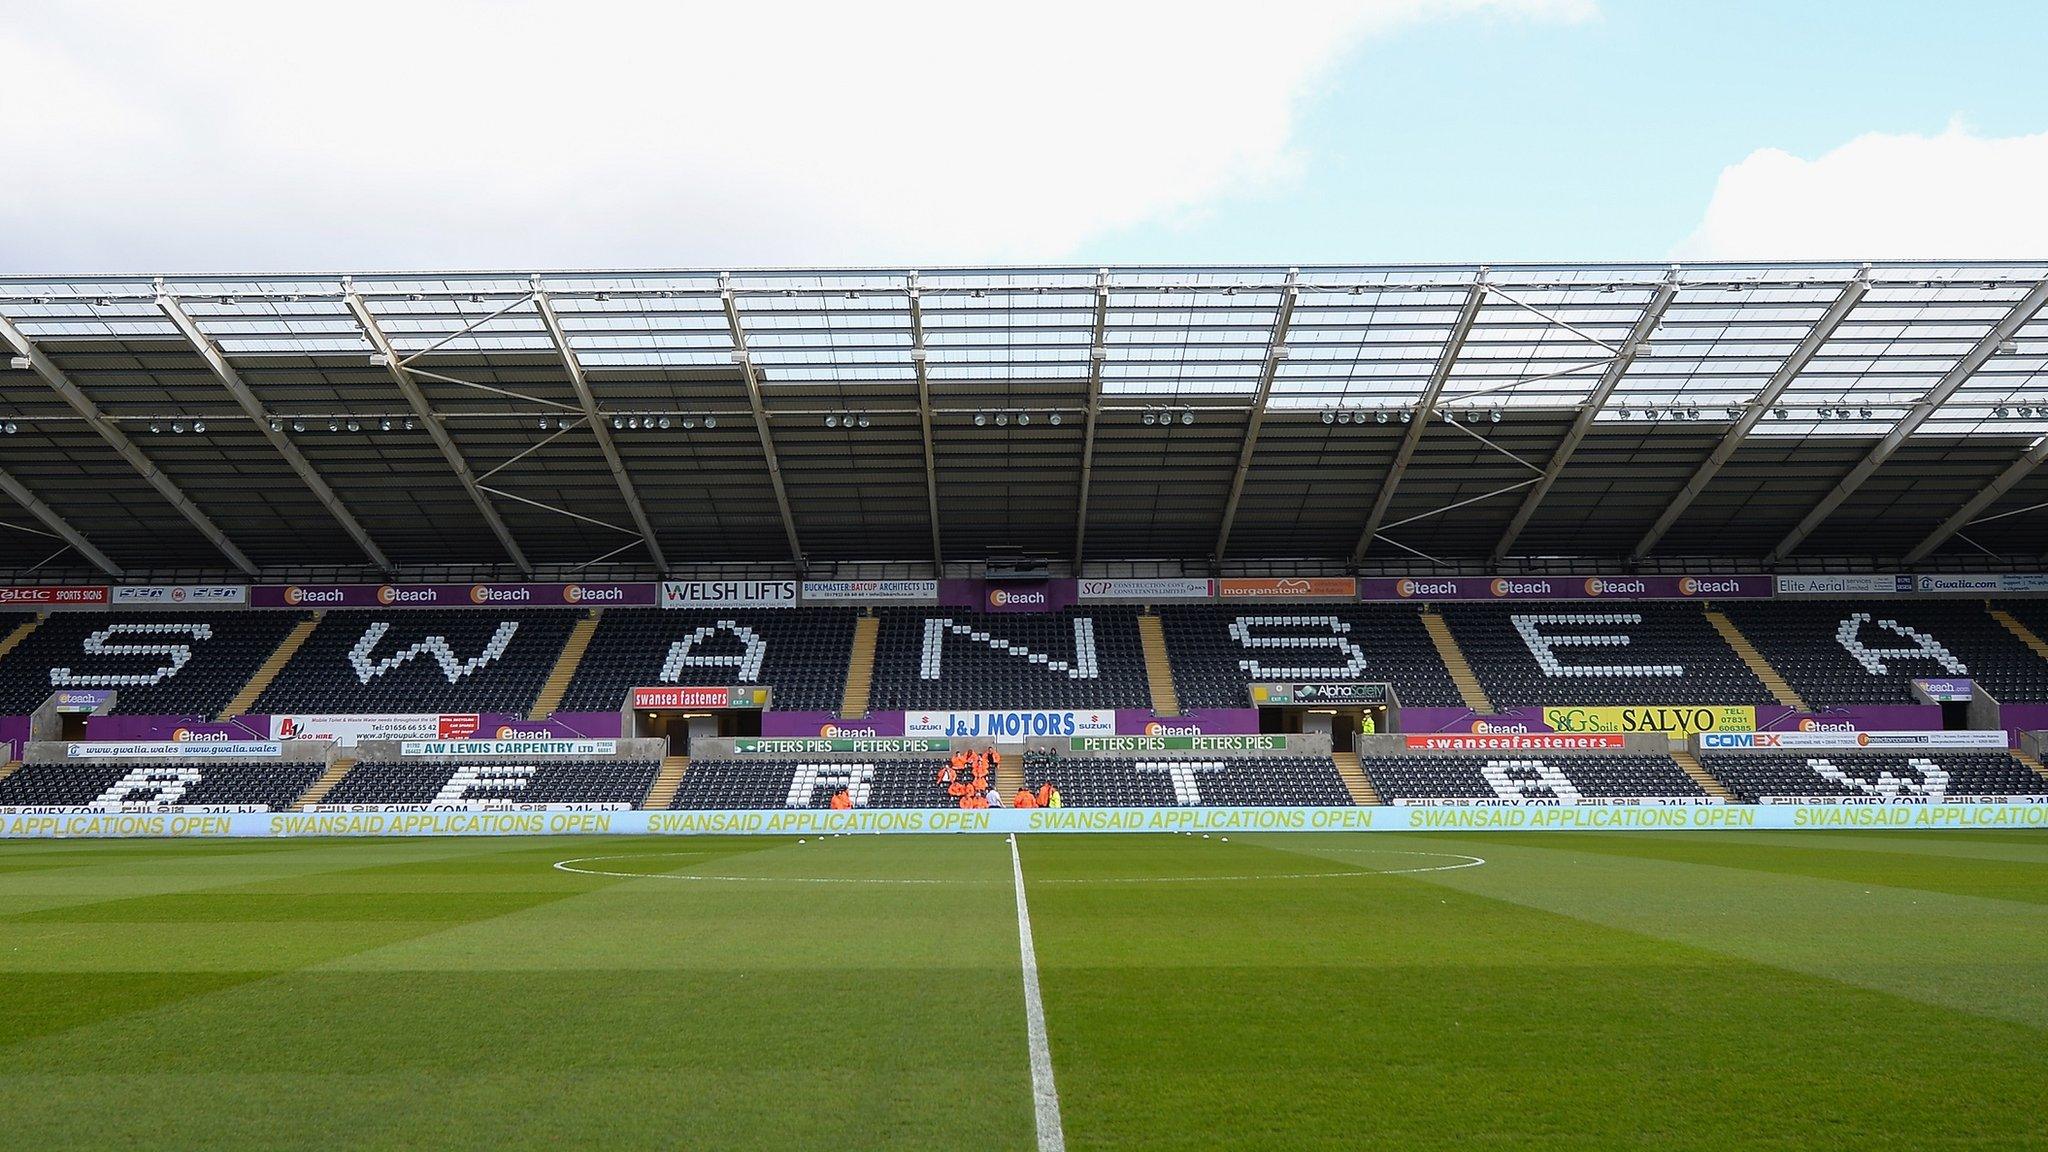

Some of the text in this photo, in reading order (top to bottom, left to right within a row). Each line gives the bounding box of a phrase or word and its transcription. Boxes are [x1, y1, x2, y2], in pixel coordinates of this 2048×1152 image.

[664, 582, 795, 600] WELSH LIFTS
[879, 582, 920, 591] ARCHITECTS
[922, 582, 935, 590] LTD
[1083, 582, 1112, 595] SCP
[1224, 587, 1307, 596] morganstone
[1403, 580, 1457, 594] eteach
[1497, 579, 1551, 593] eteach
[1591, 579, 1645, 593] eteach
[1685, 579, 1740, 593] eteach
[1780, 579, 1846, 591] Elite Aerial
[1935, 580, 1997, 589] Gwalia.com
[56, 590, 81, 600] SPORTS
[83, 590, 102, 600] SIGNS
[290, 588, 344, 602] eteach
[383, 587, 437, 601] eteach
[477, 586, 530, 600] eteach
[570, 586, 623, 600] eteach
[996, 590, 1045, 604] eteach
[636, 690, 727, 706] swansea fasteners
[1317, 684, 1384, 698] AlphaSafety
[945, 712, 1075, 737] J&J MOTORS
[1589, 715, 1619, 732] Soils
[1622, 709, 1714, 732] SALVO
[1804, 720, 1856, 732] eteach
[502, 727, 551, 739] eteach
[826, 726, 876, 738] eteach
[1151, 724, 1201, 736] eteach
[1477, 722, 1528, 734] eteach
[179, 730, 228, 741] eteach
[1706, 734, 1781, 746] COMEX
[86, 743, 277, 755] www.gwalia.wales www.gwalia.wales
[424, 743, 446, 753] AW
[450, 743, 491, 753] LEWIS
[498, 742, 574, 753] CARPENTRY
[757, 740, 832, 753] PETER'S PIES
[853, 739, 929, 752] PETER'S PIES
[1084, 738, 1165, 750] PETER'S PIES
[1192, 737, 1273, 750] PETER'S PIES
[648, 812, 990, 832] SWANSAID APPLICATIONS OPEN
[1029, 810, 1373, 829] SWANSAID APPLICATIONS OPEN
[1409, 808, 1755, 827] SWANSAID APPLICATIONS OPEN
[1794, 807, 2048, 826] SWANSAID APPLICATIO
[10, 816, 165, 835] APPLICATIONS
[171, 815, 231, 834] OPEN
[270, 814, 611, 834] SWANSAID APPLICATIONS OPEN
